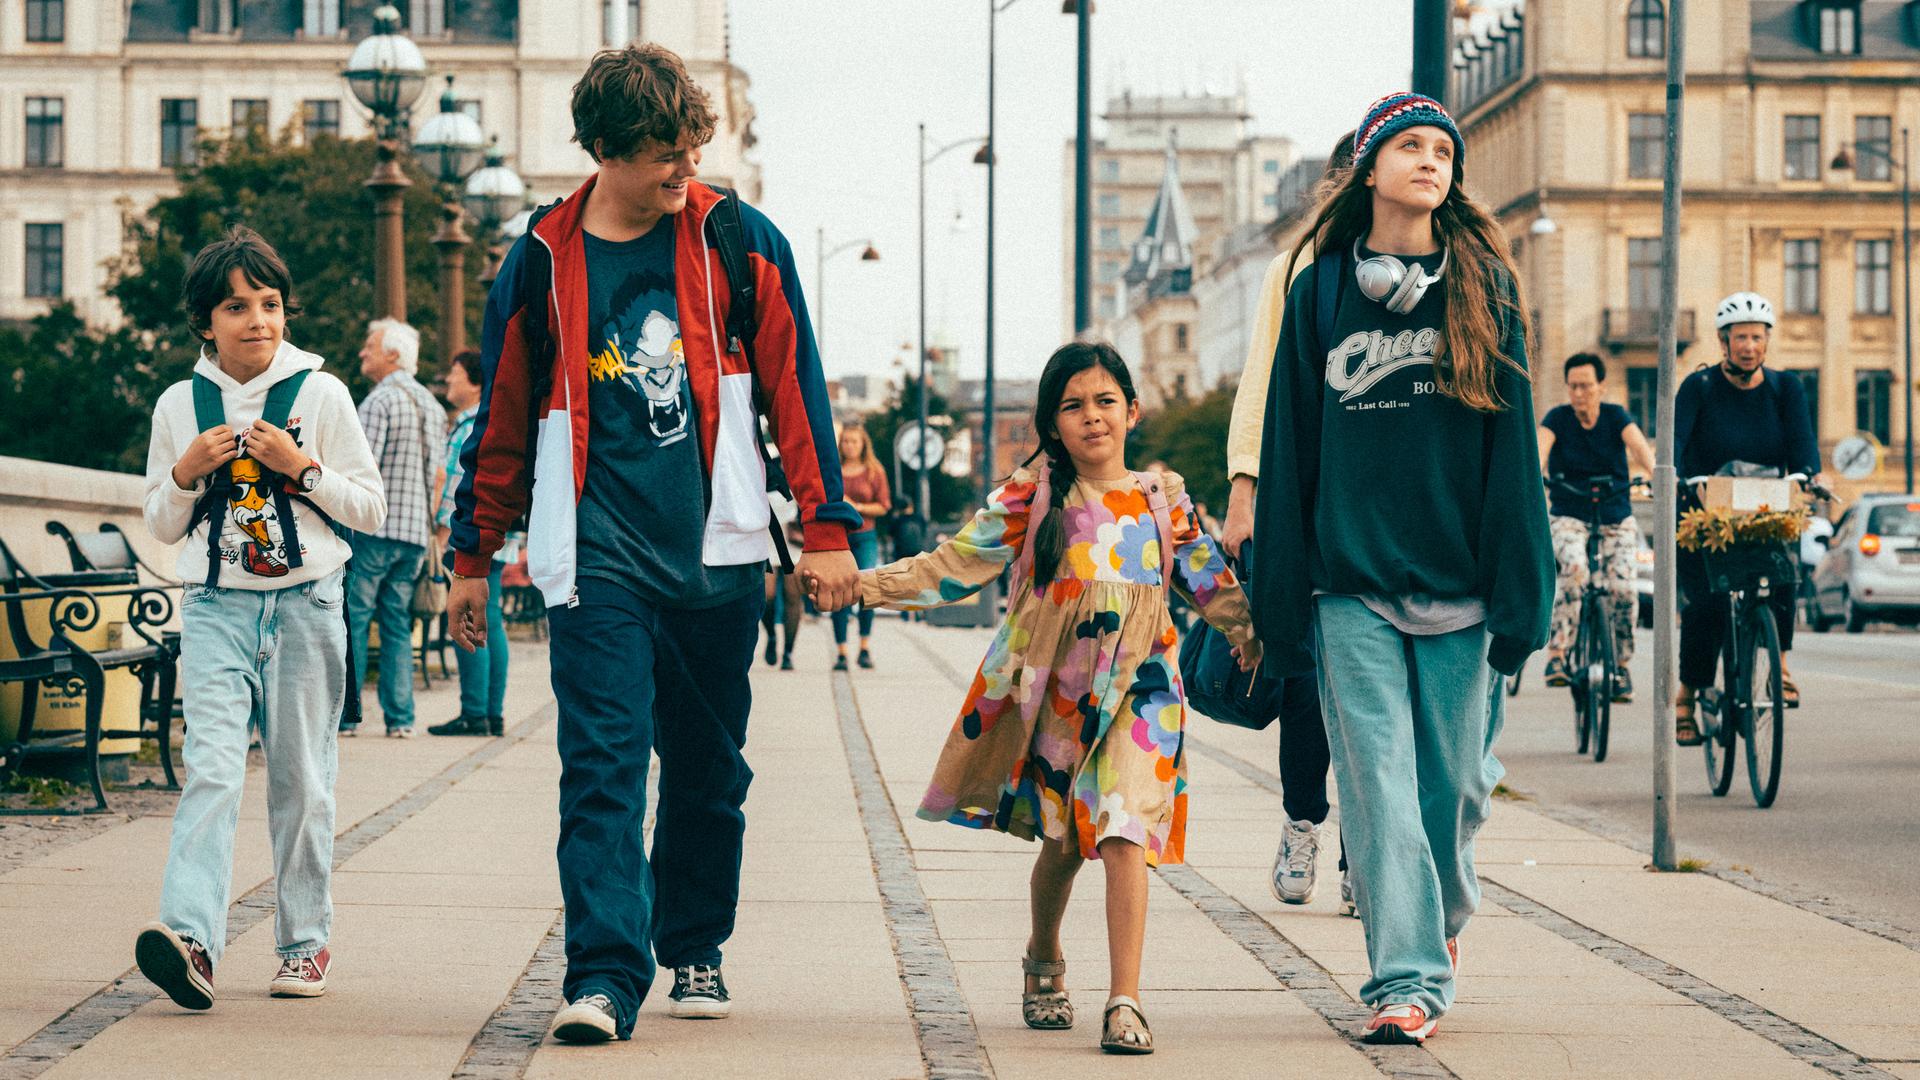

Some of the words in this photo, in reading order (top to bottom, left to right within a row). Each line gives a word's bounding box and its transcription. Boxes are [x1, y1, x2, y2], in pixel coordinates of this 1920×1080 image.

[1326, 327, 1441, 392] Chee
[1358, 402, 1377, 410] Last
[1378, 400, 1397, 408] Call
